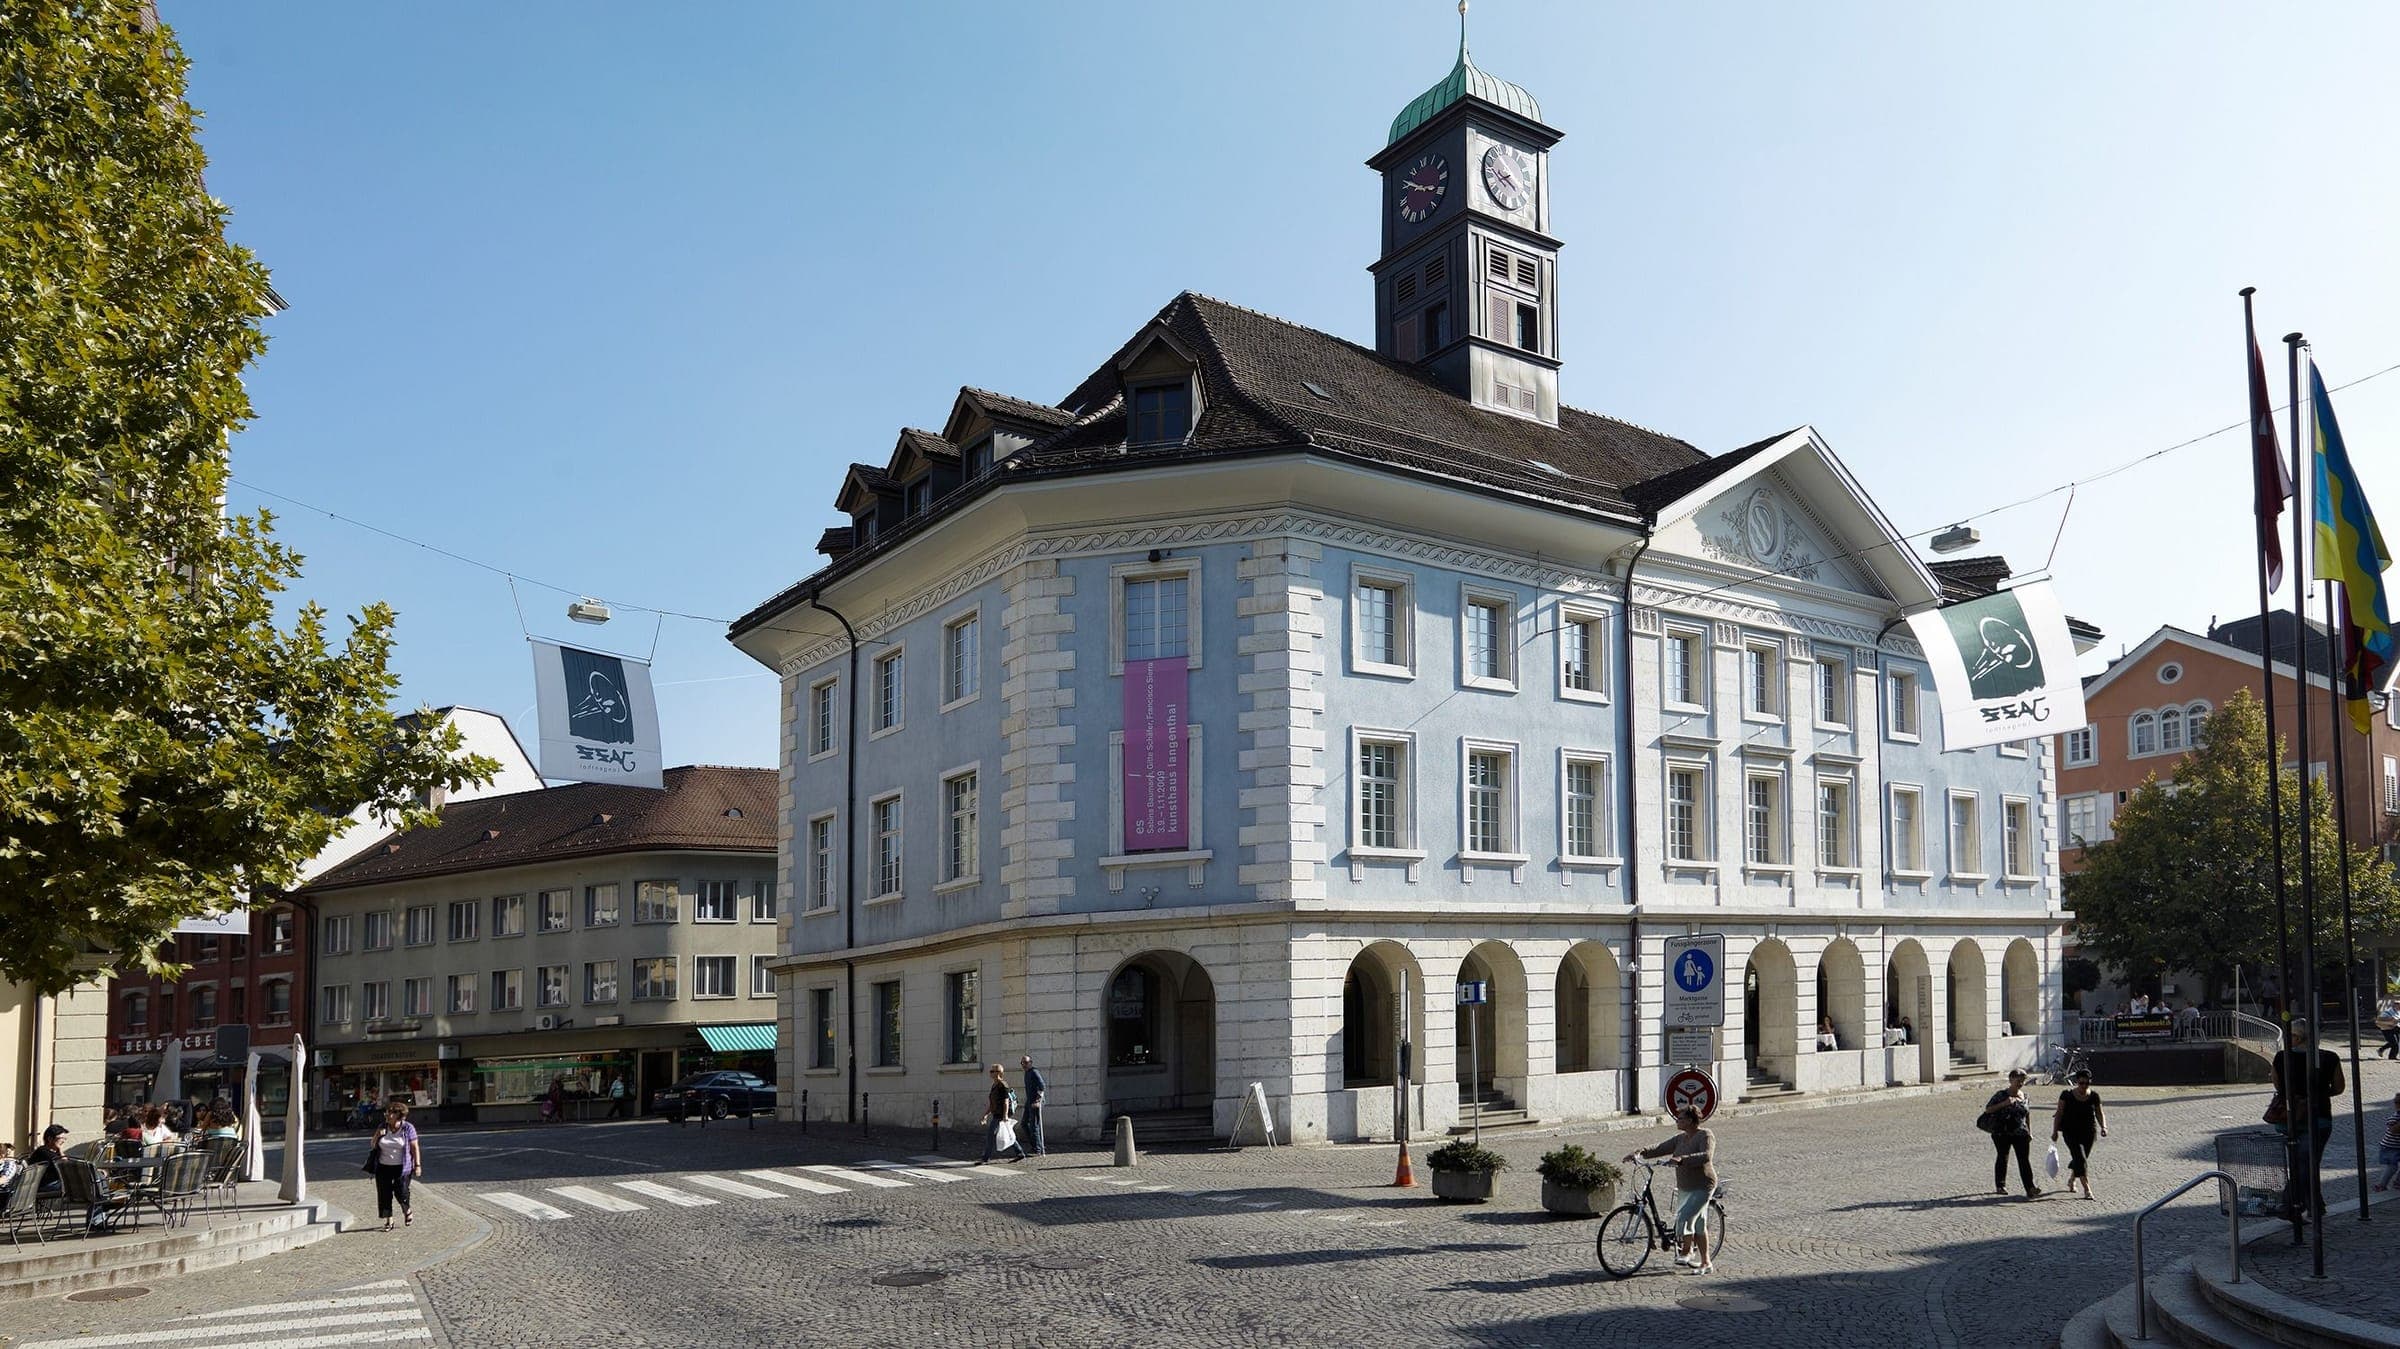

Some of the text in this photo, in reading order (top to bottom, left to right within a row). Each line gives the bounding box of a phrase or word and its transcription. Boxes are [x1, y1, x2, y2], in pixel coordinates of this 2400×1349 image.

[1146, 661, 1154, 683] Sierra
[1146, 684, 1154, 719] Francisco
[1146, 751, 1154, 769] Gitte
[1167, 704, 1178, 832] kunsthaus langenthal
[1156, 770, 1165, 809] 1.11.2009
[1136, 820, 1145, 834] es
[126, 1039, 162, 1052] BEKB
